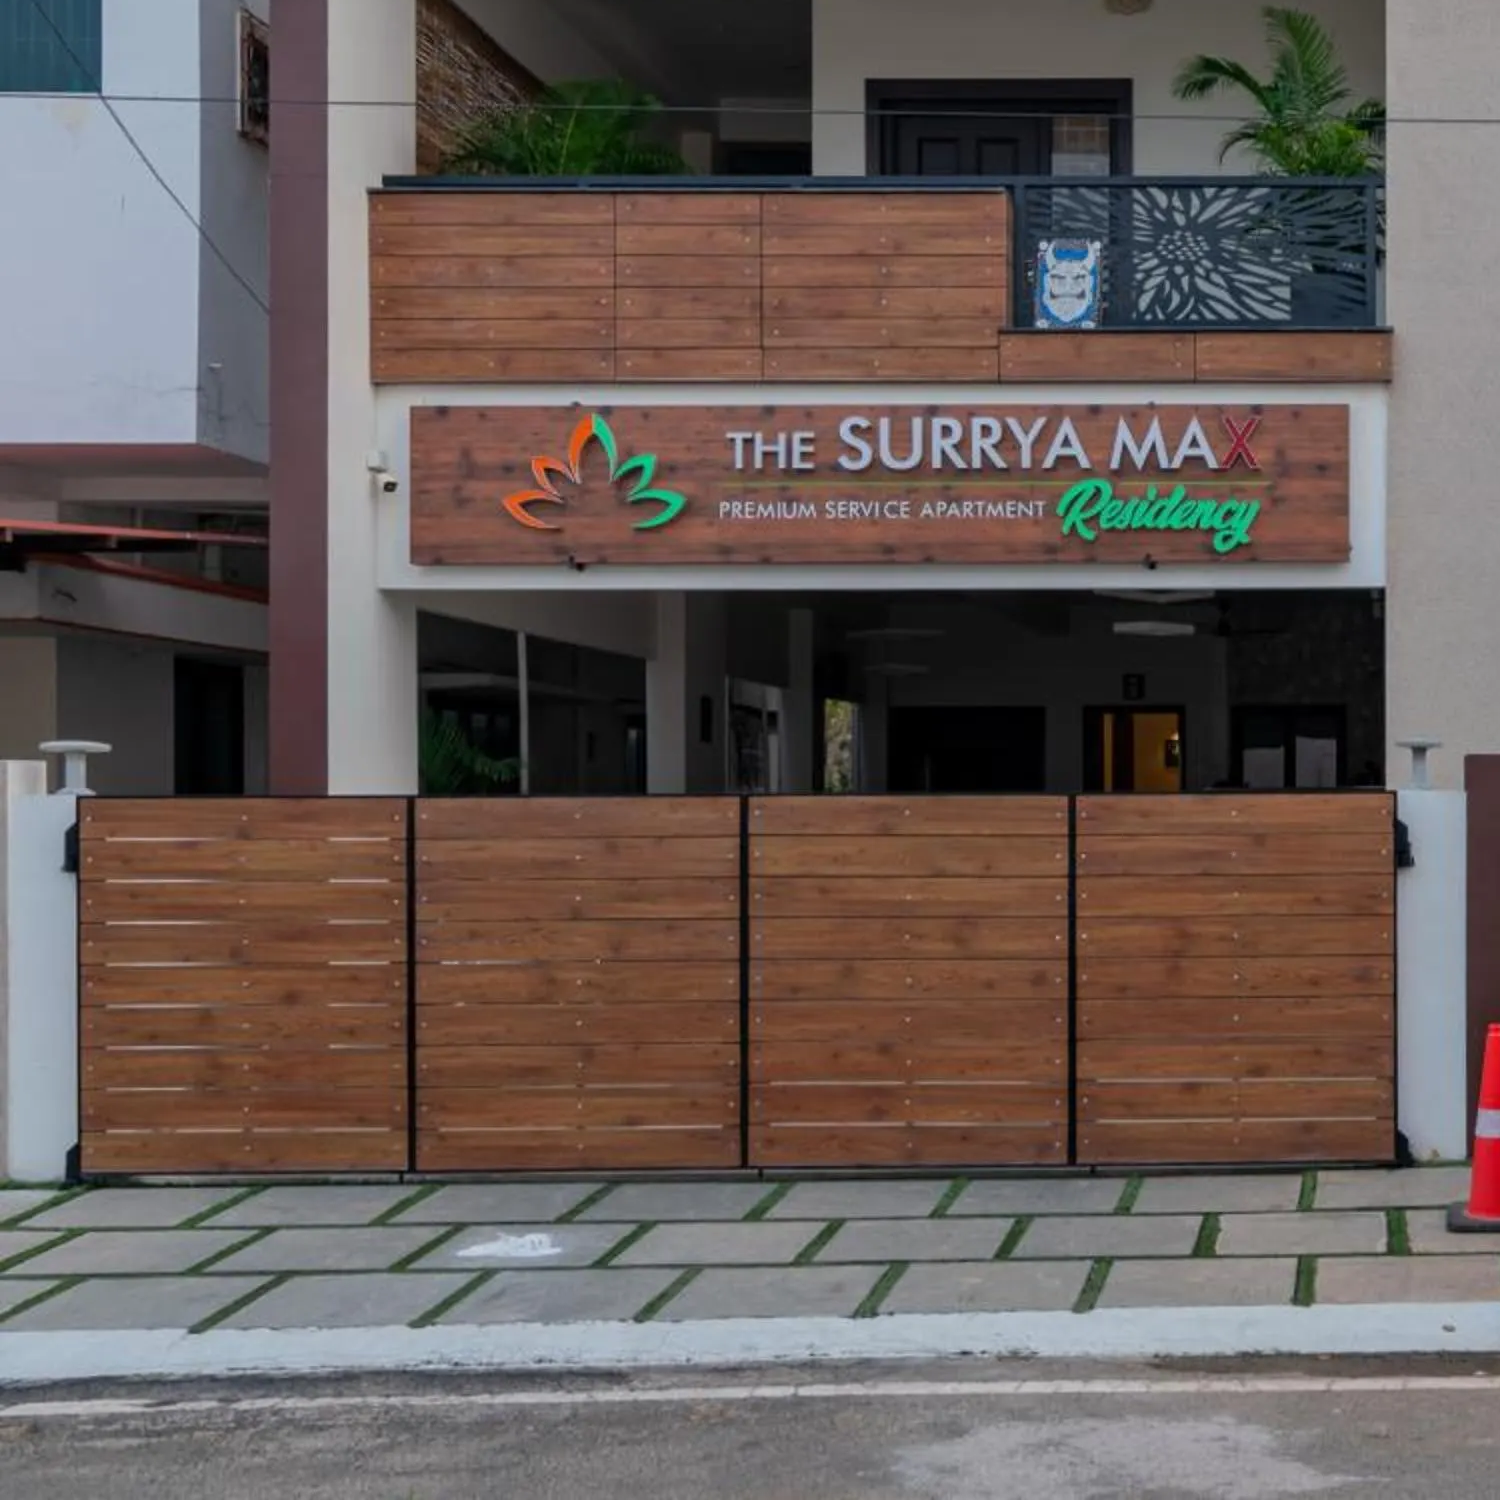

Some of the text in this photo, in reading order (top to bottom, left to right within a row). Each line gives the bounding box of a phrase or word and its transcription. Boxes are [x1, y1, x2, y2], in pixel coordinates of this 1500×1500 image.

[725, 415, 1262, 471] THE SURRYA MAX
[719, 501, 1047, 519] PREMIUM SERVICE APARTMENT
[1056, 478, 1261, 553] Residency
